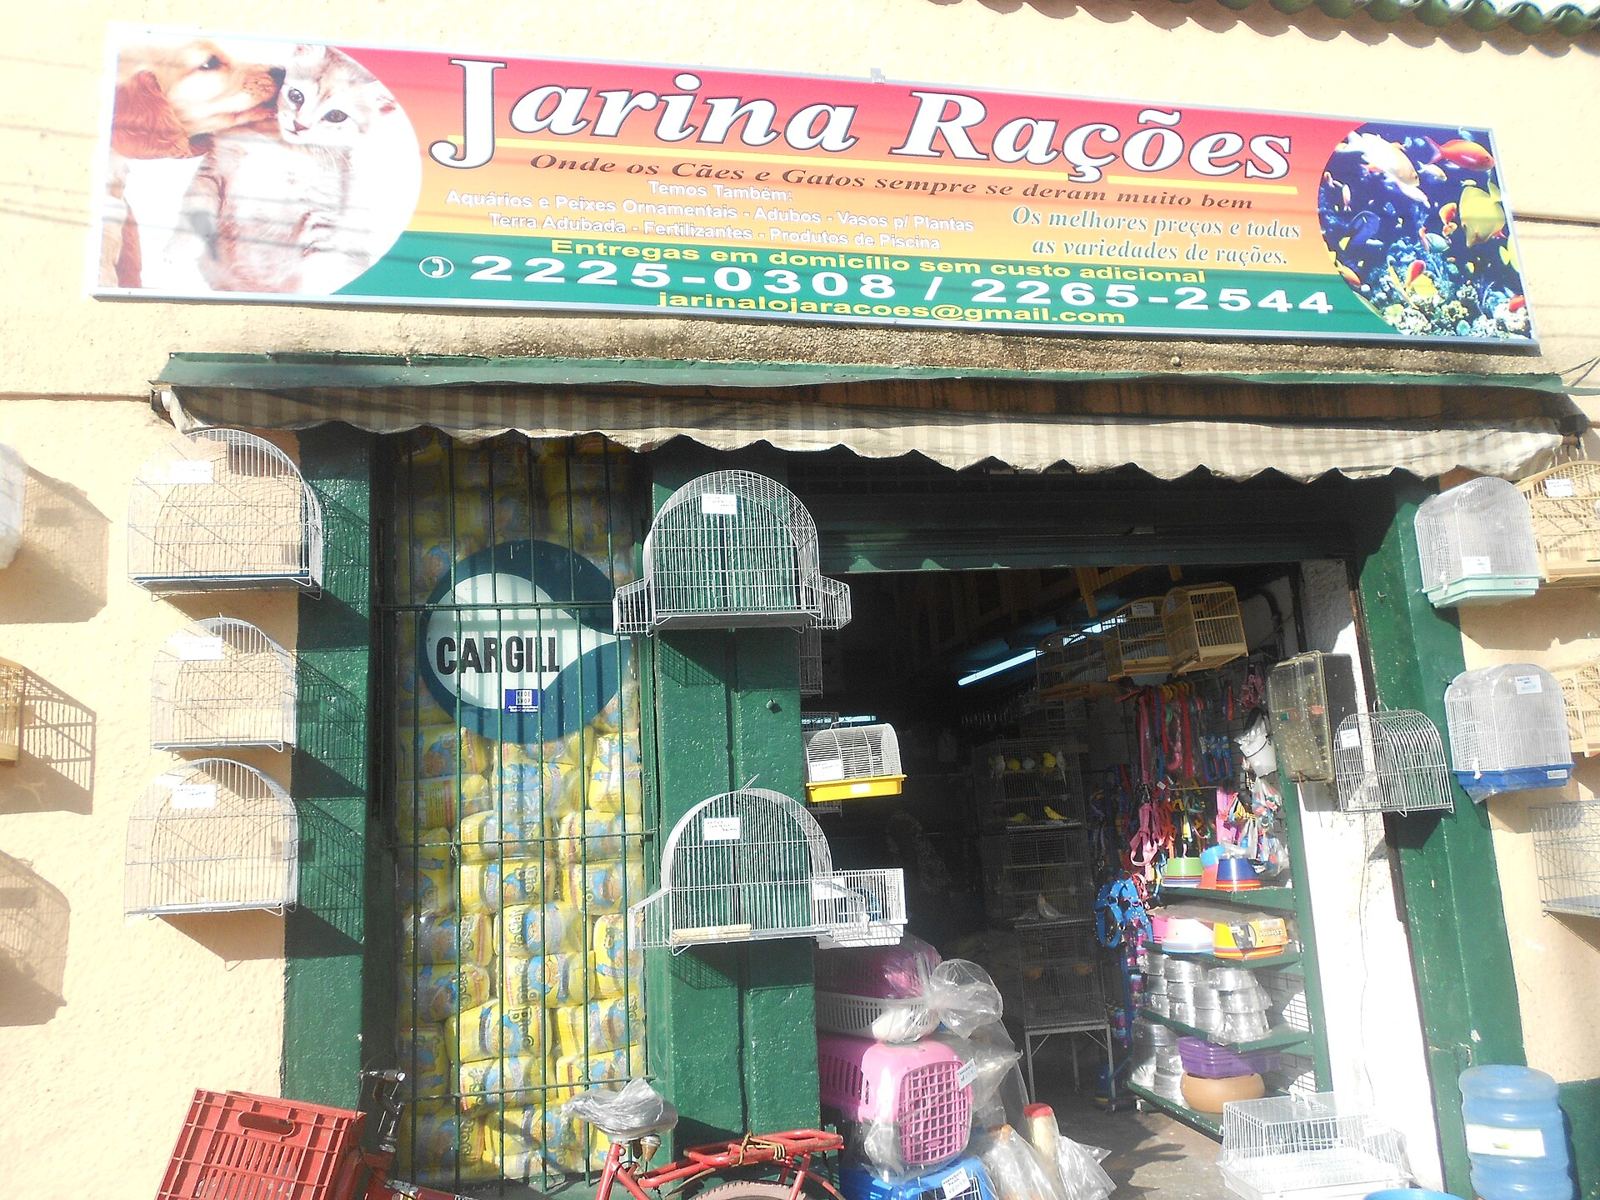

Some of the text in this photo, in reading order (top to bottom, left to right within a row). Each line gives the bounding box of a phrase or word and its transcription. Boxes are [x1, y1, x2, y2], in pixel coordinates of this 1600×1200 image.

[428, 57, 1291, 184] Jarina Rações
[530, 153, 1253, 209] Onde os Cães e Gatos sempre se deram muito bem
[647, 180, 793, 201] Temos Também:
[445, 189, 532, 209] Aquários
[538, 197, 550, 209] e
[555, 195, 617, 213] Peixes
[622, 199, 738, 220] Ornamentais
[754, 207, 821, 224] Adubos
[837, 210, 889, 227] Vasos
[913, 215, 975, 232] Plantas
[1011, 205, 1301, 239] Os melhores preços e todas
[488, 211, 537, 229] Terra
[542, 215, 626, 234] Adubada
[643, 220, 752, 240] Fertilizantes
[769, 227, 849, 246] Produtos
[854, 232, 875, 247] de
[879, 233, 941, 250] Piscina
[551, 239, 1206, 284] Entregas em domicílio sem custo adicional
[1032, 239, 1288, 268] as variedades de rações.
[470, 255, 1334, 314] 2225-0308 / 2265-2544
[657, 291, 1126, 325] jarinalojaracoes@gmail.com
[437, 636, 560, 675] CARGILL
